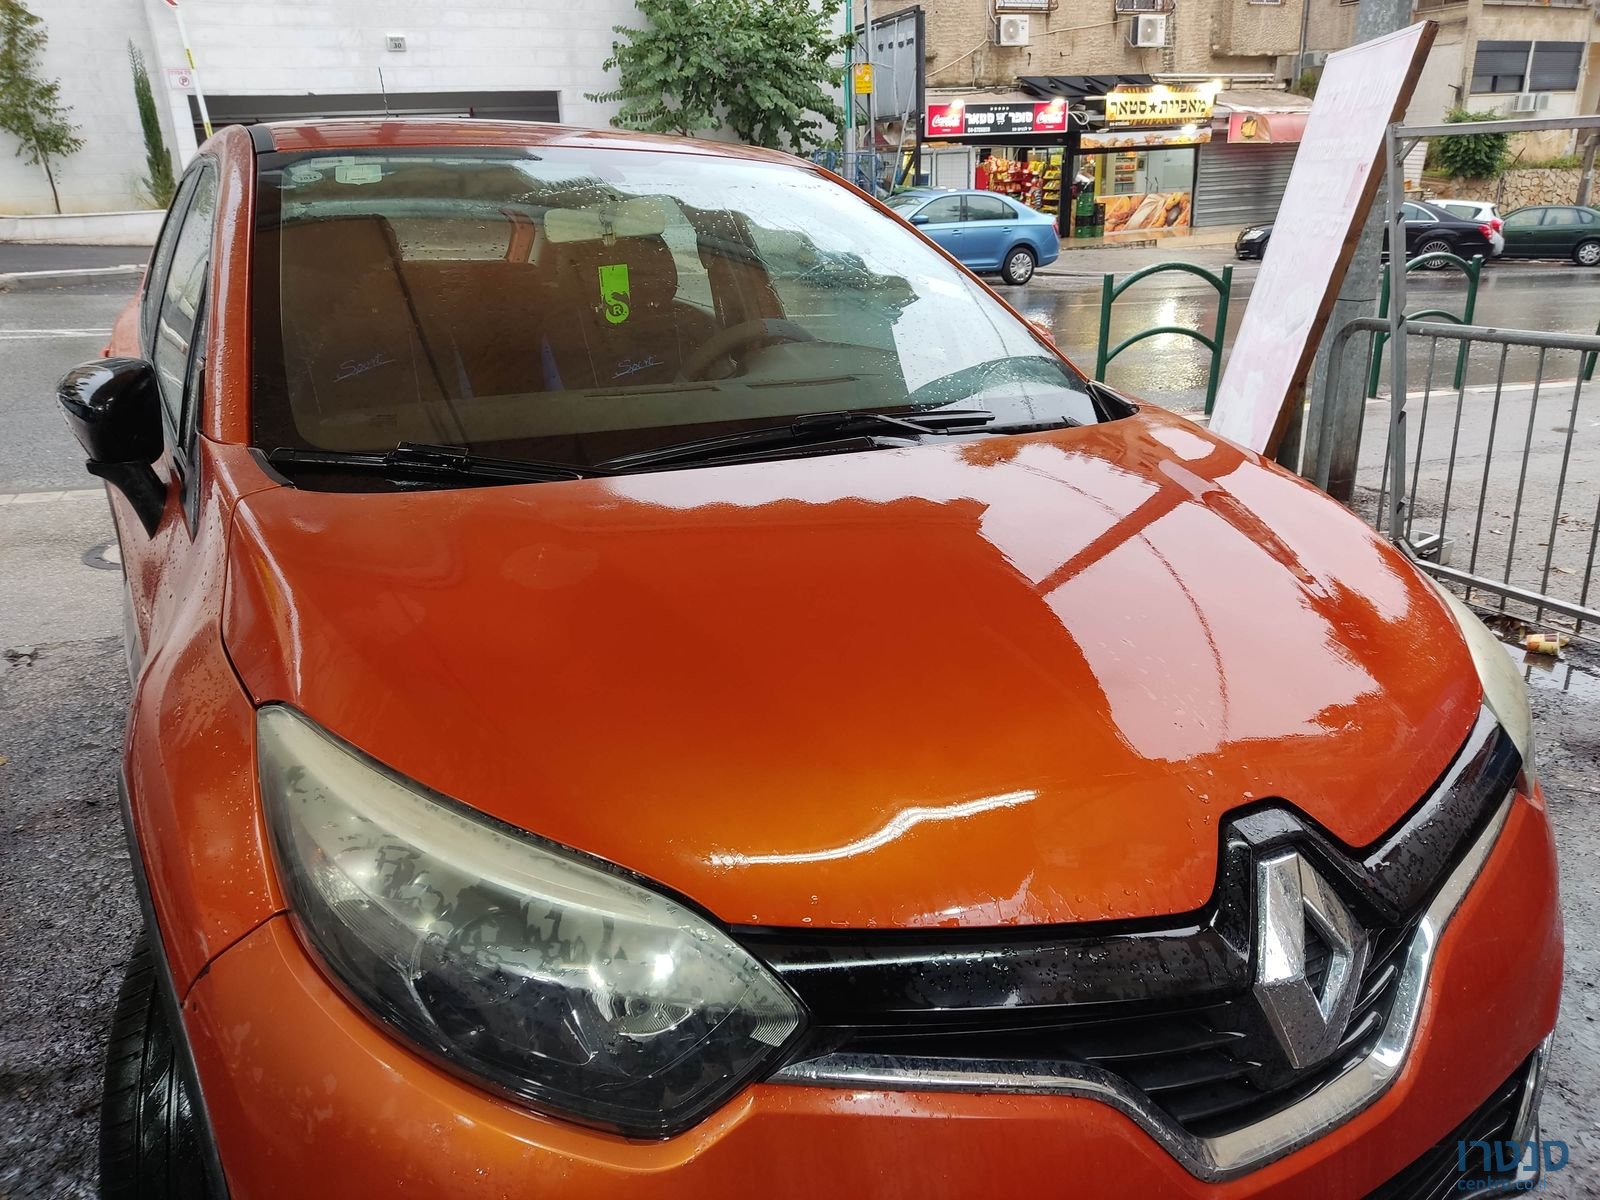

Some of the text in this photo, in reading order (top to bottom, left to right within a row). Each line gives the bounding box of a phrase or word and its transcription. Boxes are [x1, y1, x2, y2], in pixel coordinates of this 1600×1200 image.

[1110, 99, 1207, 115] מאפיית סטאר
[1008, 111, 1034, 124] סופר
